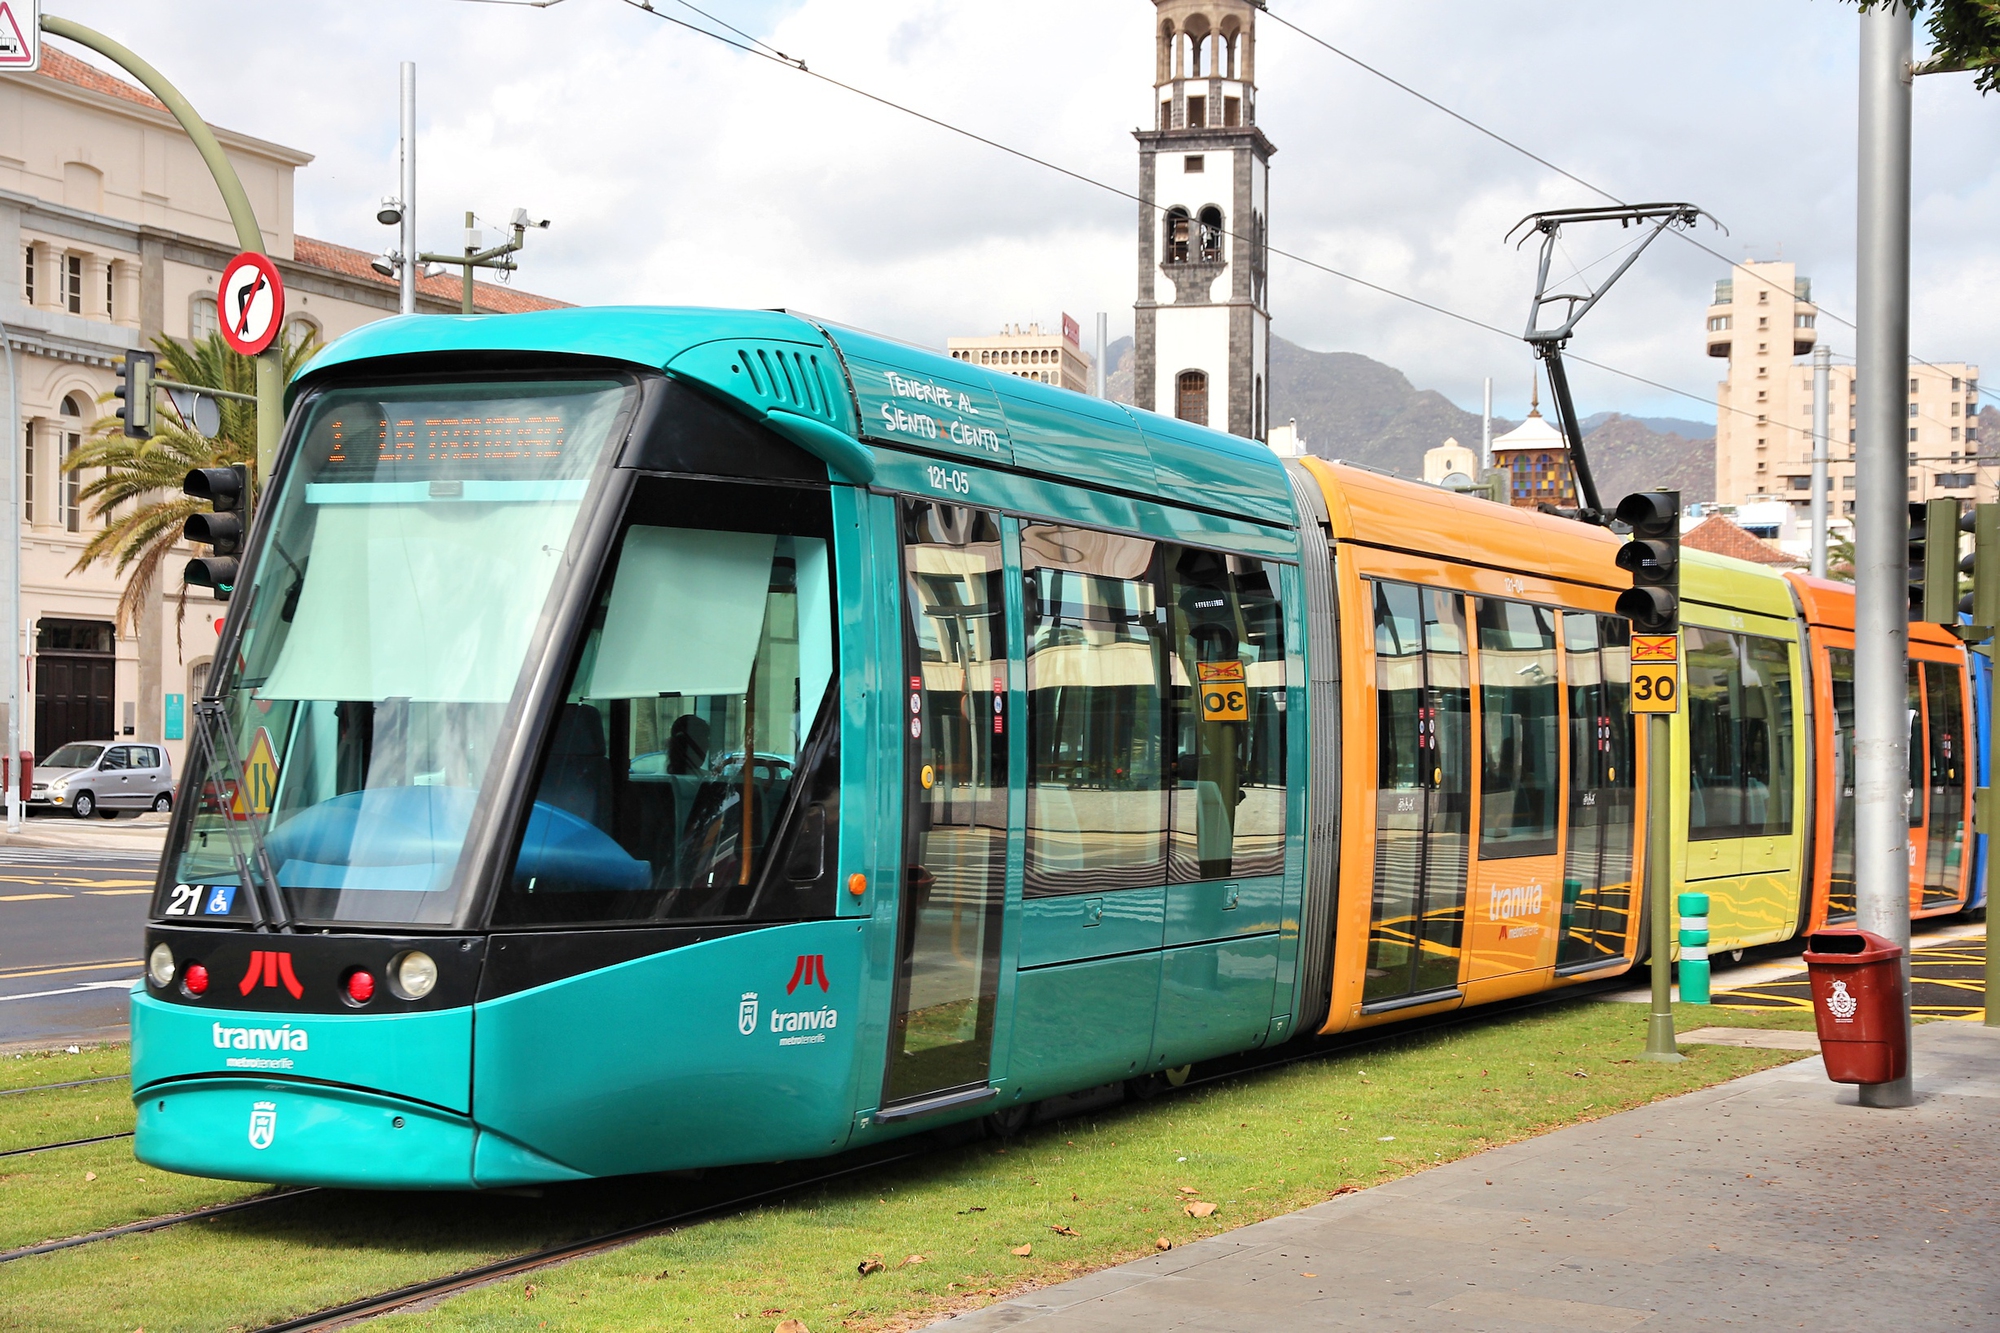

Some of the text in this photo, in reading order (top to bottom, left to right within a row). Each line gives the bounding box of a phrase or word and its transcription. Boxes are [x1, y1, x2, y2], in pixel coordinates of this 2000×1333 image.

[958, 393, 978, 414] AL
[881, 400, 999, 452] SIENTO CIENTO
[927, 465, 969, 494] 121-05
[1634, 675, 1675, 701] 30
[165, 884, 204, 916] 21
[1490, 877, 1542, 921] tranvía
[770, 1004, 838, 1033] tranvía
[212, 1021, 308, 1051] tranvía
